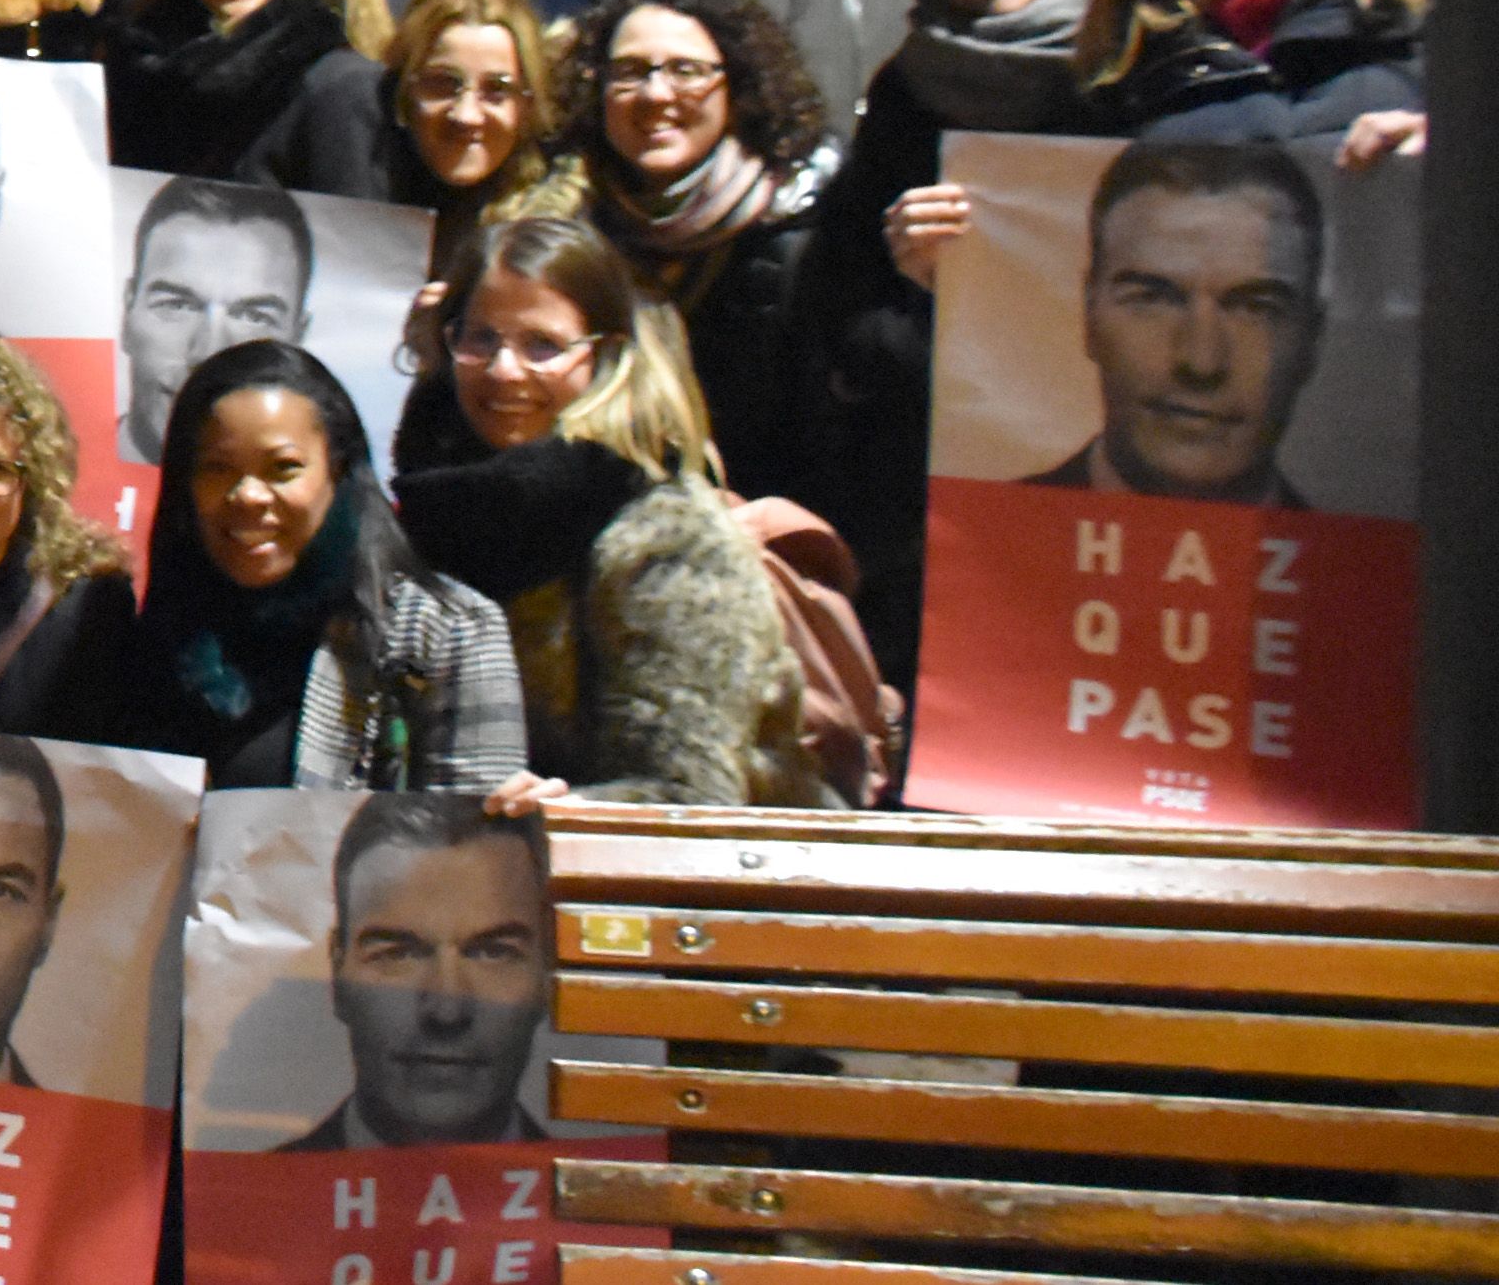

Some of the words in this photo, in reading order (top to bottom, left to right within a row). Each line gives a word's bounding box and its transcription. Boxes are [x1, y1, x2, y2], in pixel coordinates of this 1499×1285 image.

[1076, 520, 1301, 594] HAZ
[1073, 599, 1300, 676] QUE
[1066, 678, 1295, 758] PASE
[333, 1169, 541, 1230] HAZ
